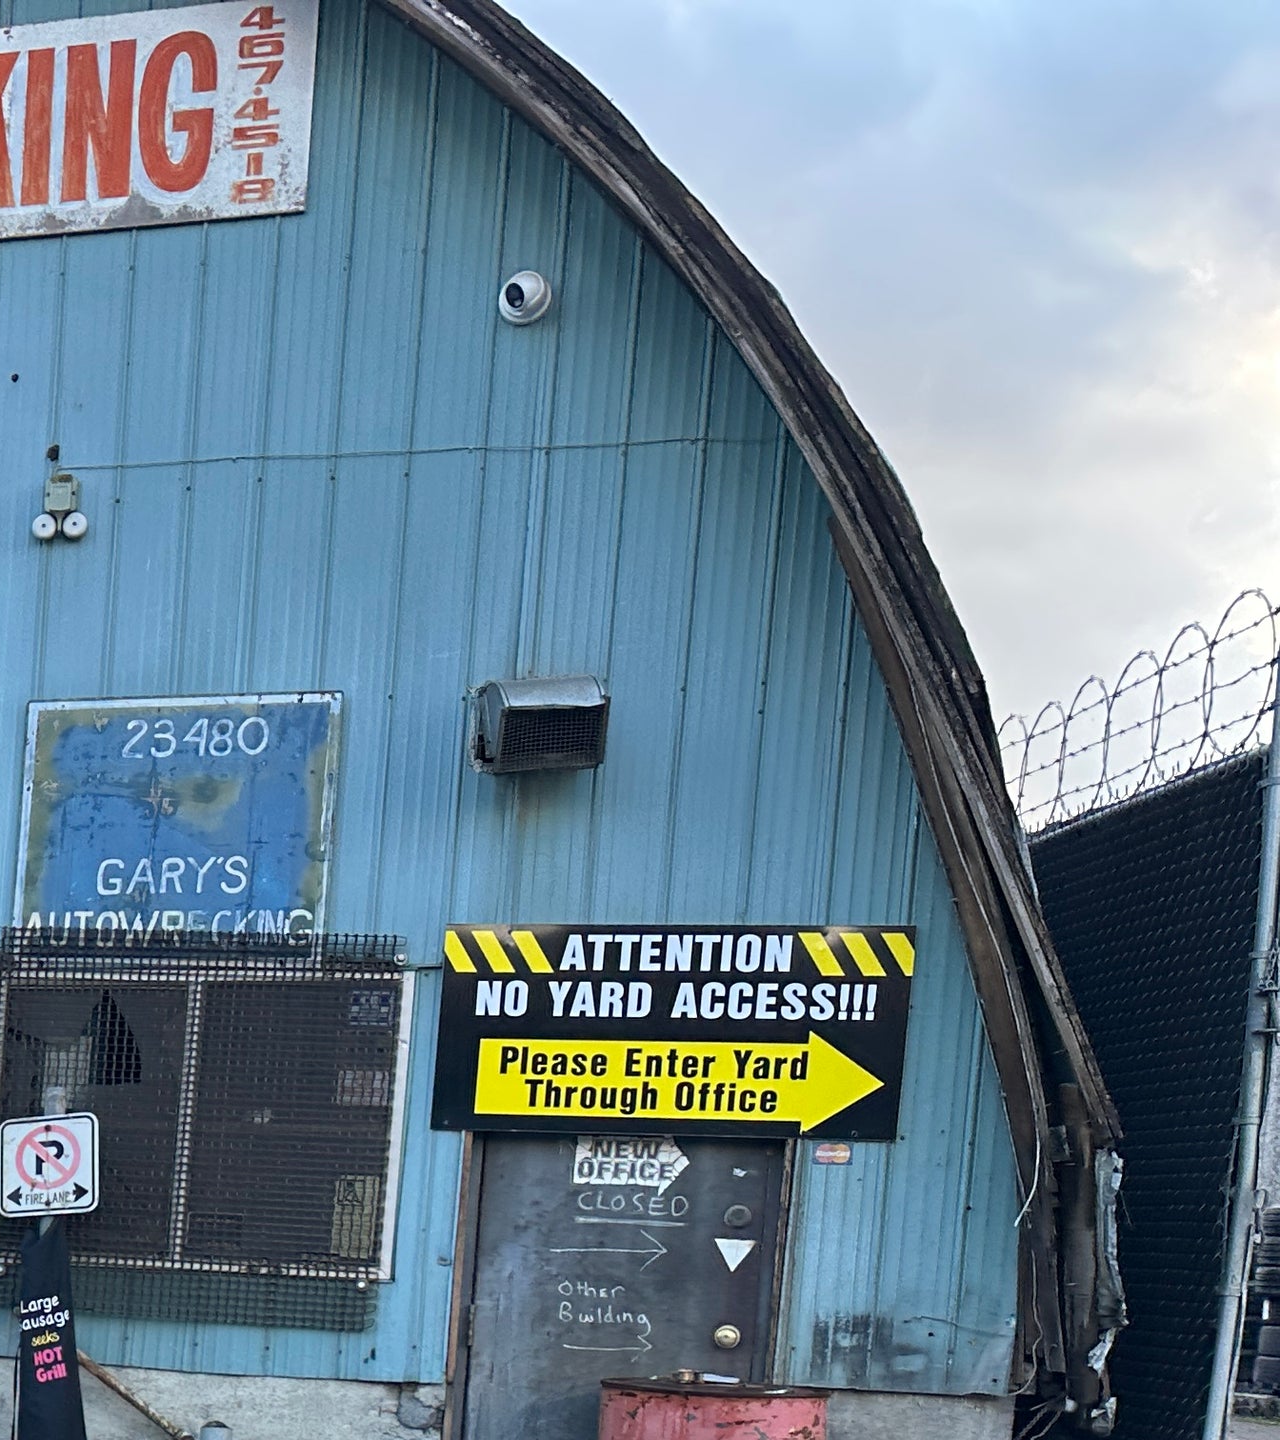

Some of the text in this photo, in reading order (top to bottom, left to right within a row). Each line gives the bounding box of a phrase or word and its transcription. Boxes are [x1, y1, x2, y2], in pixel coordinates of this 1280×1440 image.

[122, 716, 270, 759] 23480
[96, 855, 250, 896] GARY'S
[558, 933, 794, 973] ATTENTION
[475, 980, 878, 1022] NO YARD ACCESS!!!
[499, 1046, 810, 1081] Please Enter Yard
[524, 1079, 778, 1116] Through Office
[591, 1138, 661, 1160] NEW
[577, 1156, 676, 1180] OFFICE
[25, 1193, 44, 1206] FIRE
[577, 1190, 689, 1217] CLOSED
[558, 1280, 626, 1298] Other
[20, 1295, 60, 1314] Large
[20, 1309, 70, 1332] ausage
[559, 1301, 652, 1338] Building
[31, 1330, 60, 1347] seeks
[34, 1346, 63, 1366] HOT
[36, 1363, 67, 1383] Grill
